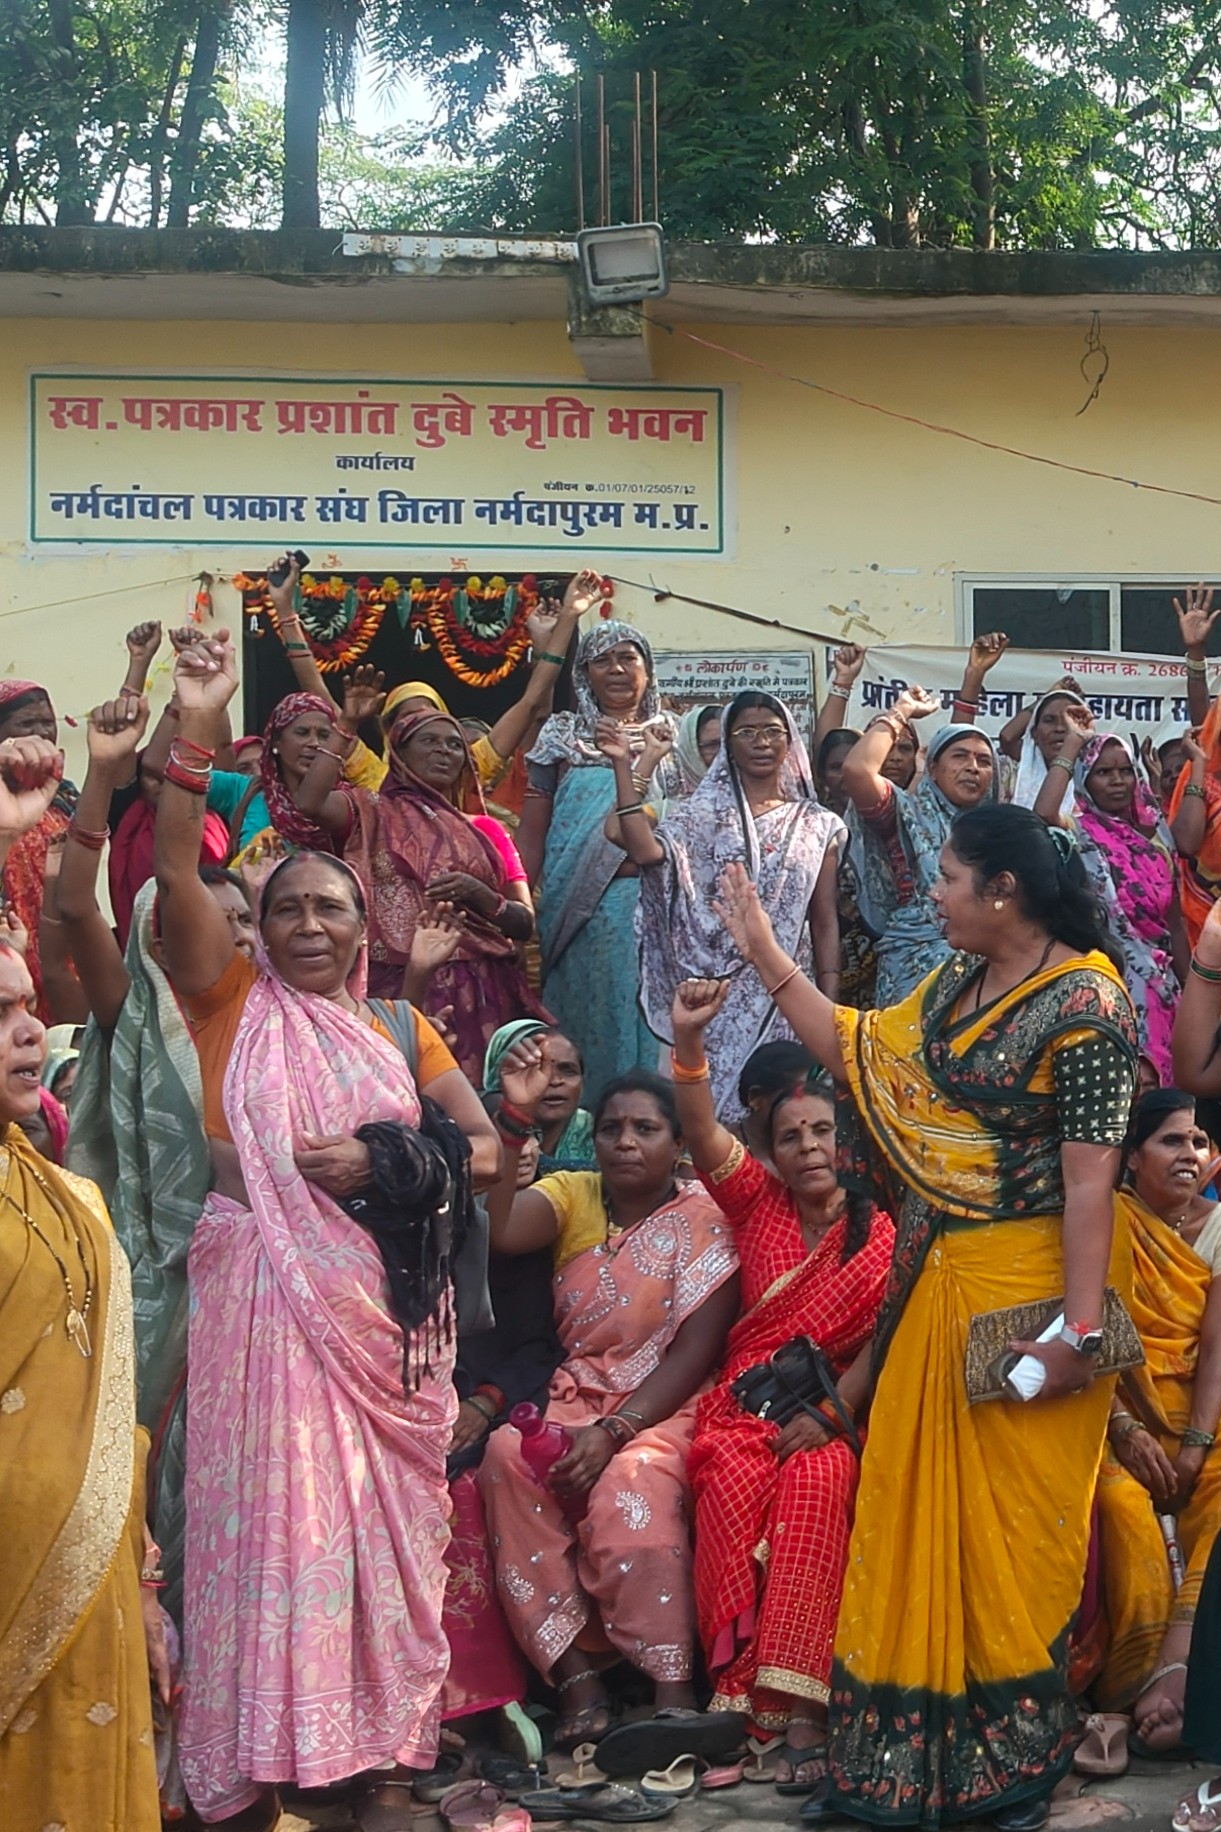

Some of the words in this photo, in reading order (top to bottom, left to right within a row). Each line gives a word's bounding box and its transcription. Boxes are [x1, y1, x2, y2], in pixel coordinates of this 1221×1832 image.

[275, 390, 399, 434] प्रशांत
[411, 393, 476, 448] दुबे
[487, 397, 594, 450] स्मृति
[608, 408, 707, 442] भवन
[336, 451, 416, 470] कार्यालय
[49, 484, 194, 520] नर्मदांचल
[203, 494, 308, 521] पत्रकार
[315, 488, 369, 522] संघ
[378, 490, 465, 524] जिला
[473, 491, 625, 536] नर्मदापुरम
[697, 659, 749, 673] लोकार्पण
[1061, 657, 1117, 674] पंजीयन
[1121, 663, 1141, 676] क्र.
[1148, 664, 1190, 677] 2686
[861, 675, 933, 710] प्रांती
[1083, 693, 1165, 722] हायता
